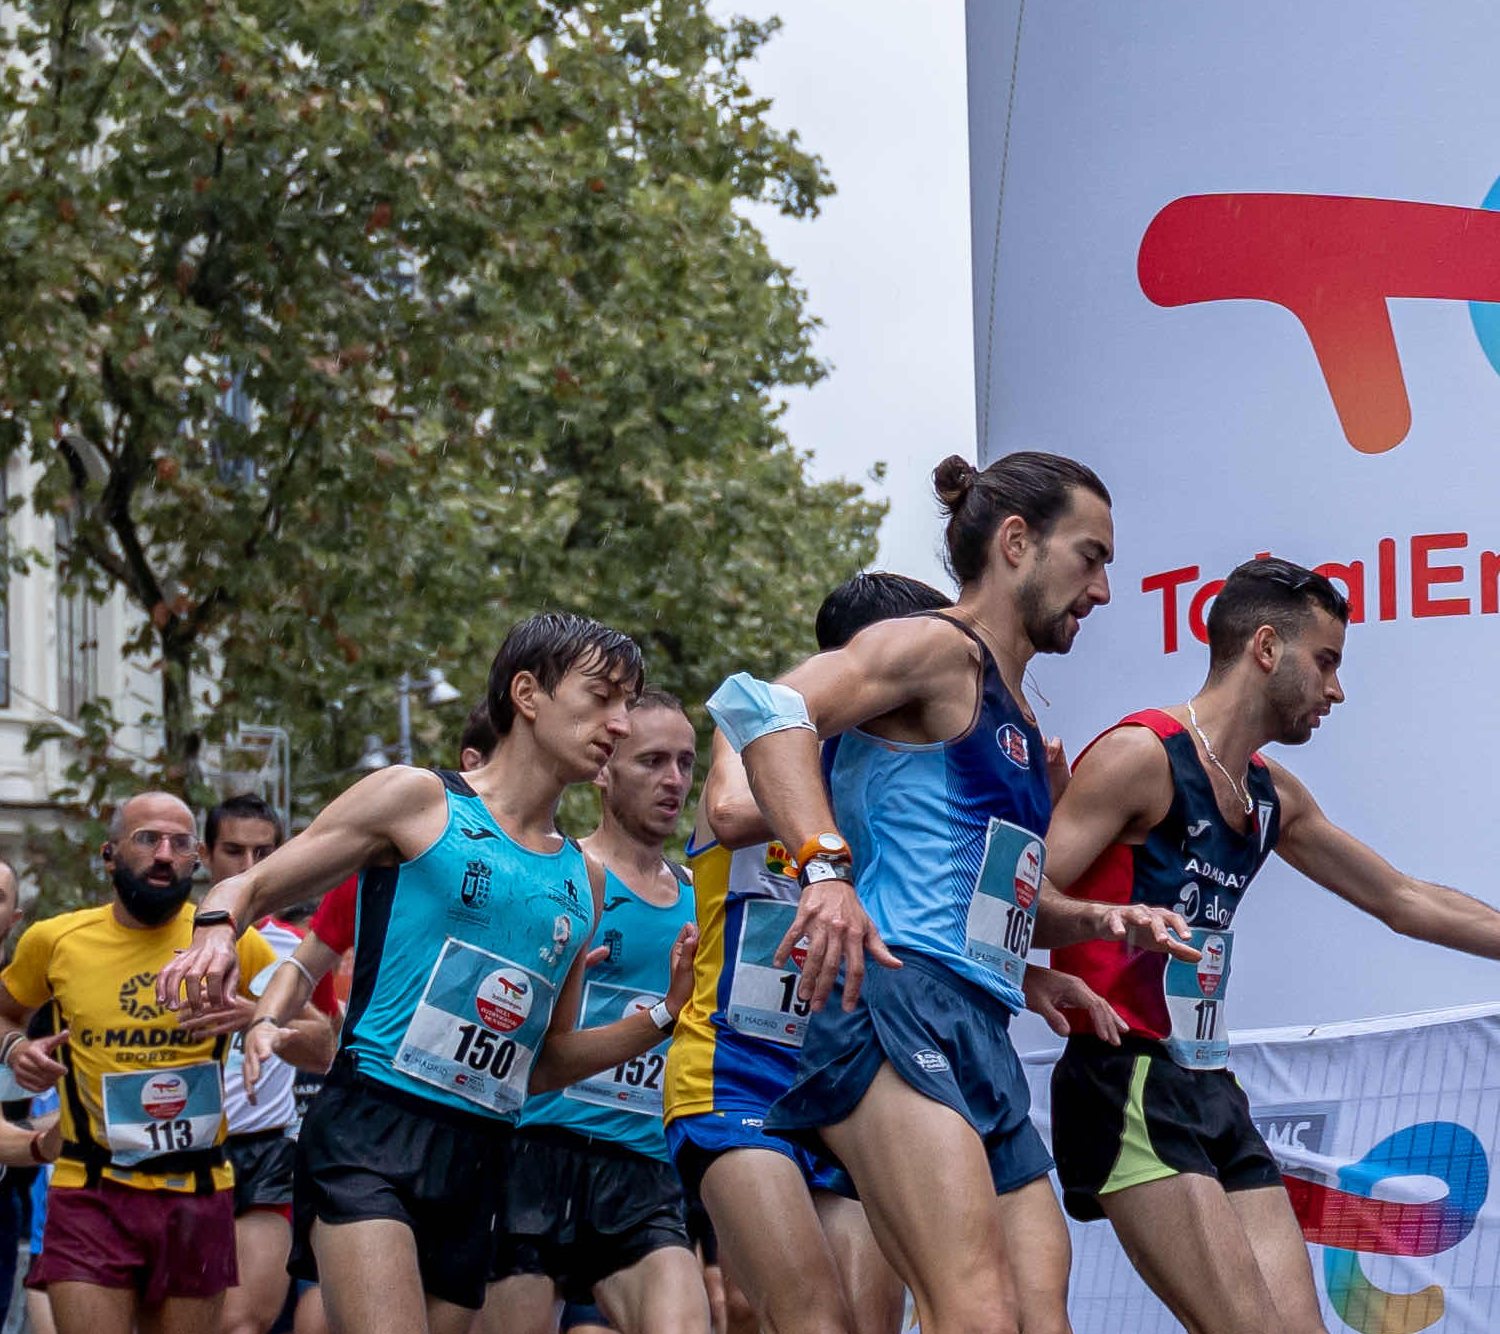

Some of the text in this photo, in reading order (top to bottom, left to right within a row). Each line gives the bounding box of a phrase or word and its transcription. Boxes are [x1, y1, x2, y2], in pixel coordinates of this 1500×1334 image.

[1003, 906, 1033, 959] 105
[744, 1013, 778, 1030] MADRID
[115, 1051, 178, 1063] SPORTS
[454, 1024, 517, 1080] 150
[613, 1053, 665, 1090] 152
[144, 1119, 194, 1150] 113
